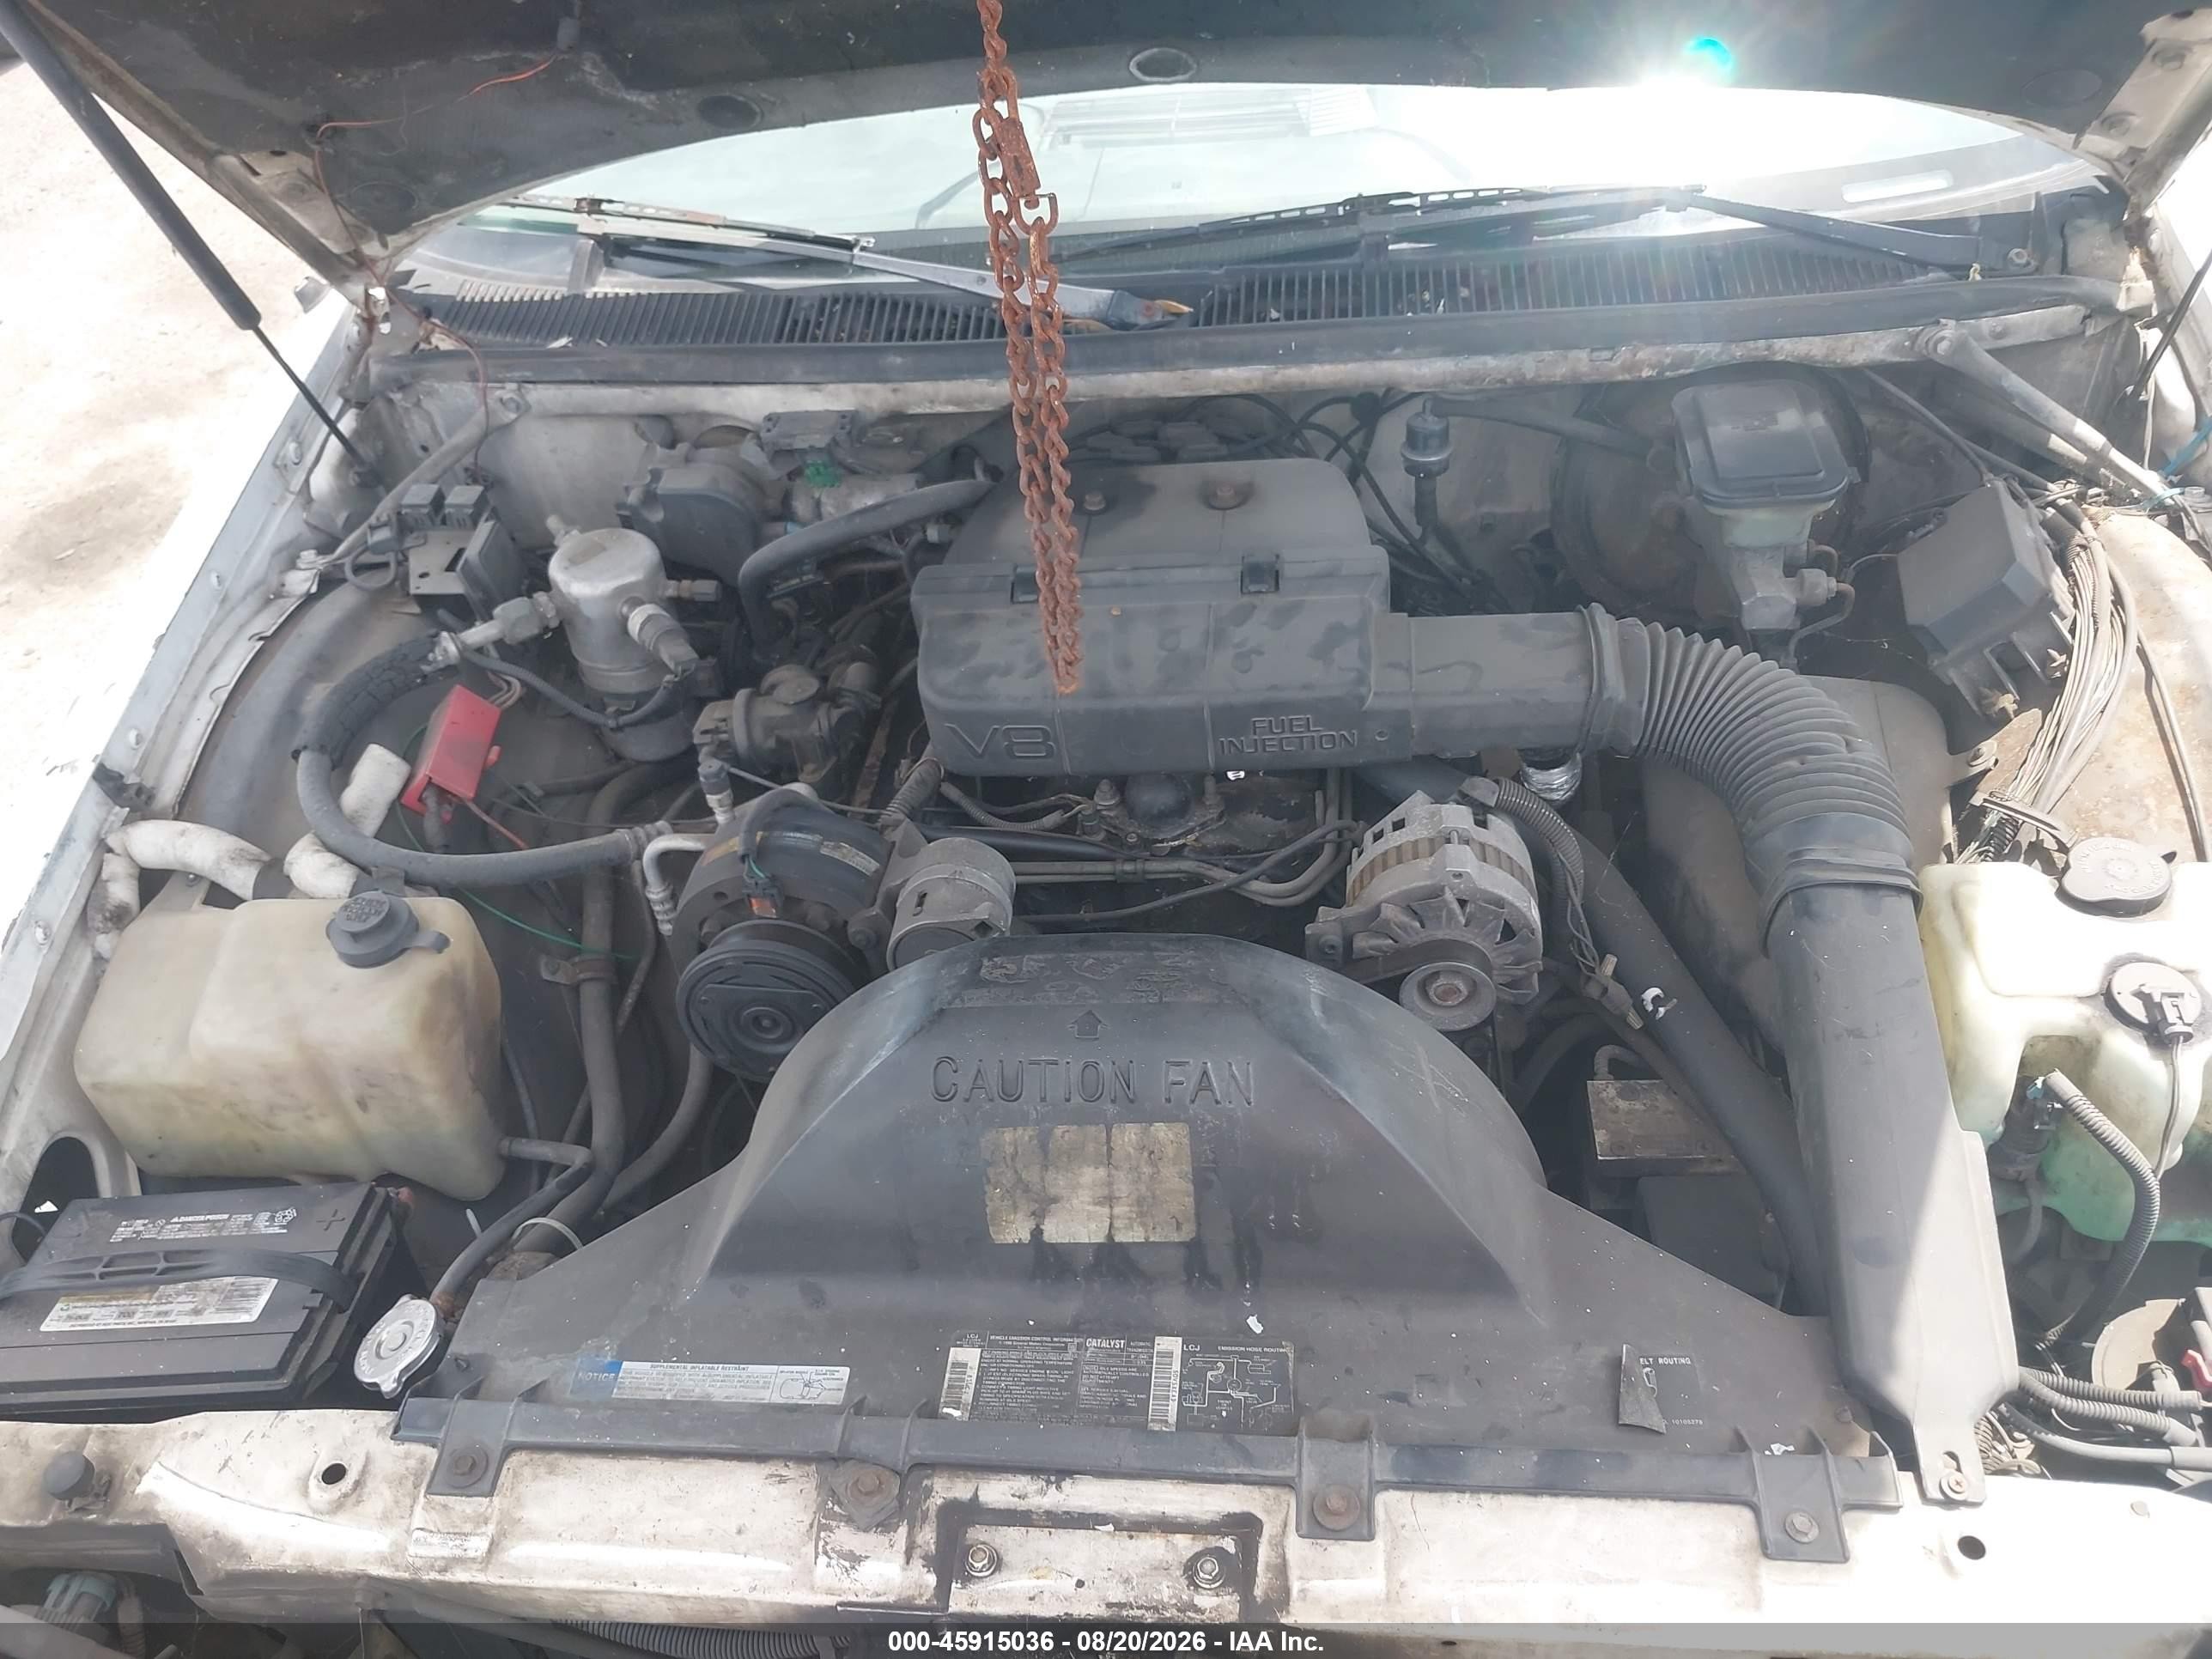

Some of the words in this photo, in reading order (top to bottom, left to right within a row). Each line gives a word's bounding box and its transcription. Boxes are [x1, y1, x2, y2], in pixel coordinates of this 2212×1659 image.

[1251, 714, 1324, 736] FUEL
[945, 724, 1056, 760] V8
[1218, 730, 1358, 756] INJECTION
[931, 1056, 1138, 1104] CAUTION
[1162, 1059, 1255, 1107] FAN
[1085, 1338, 1125, 1348] CATALYST
[577, 1372, 617, 1382] NOTICE
